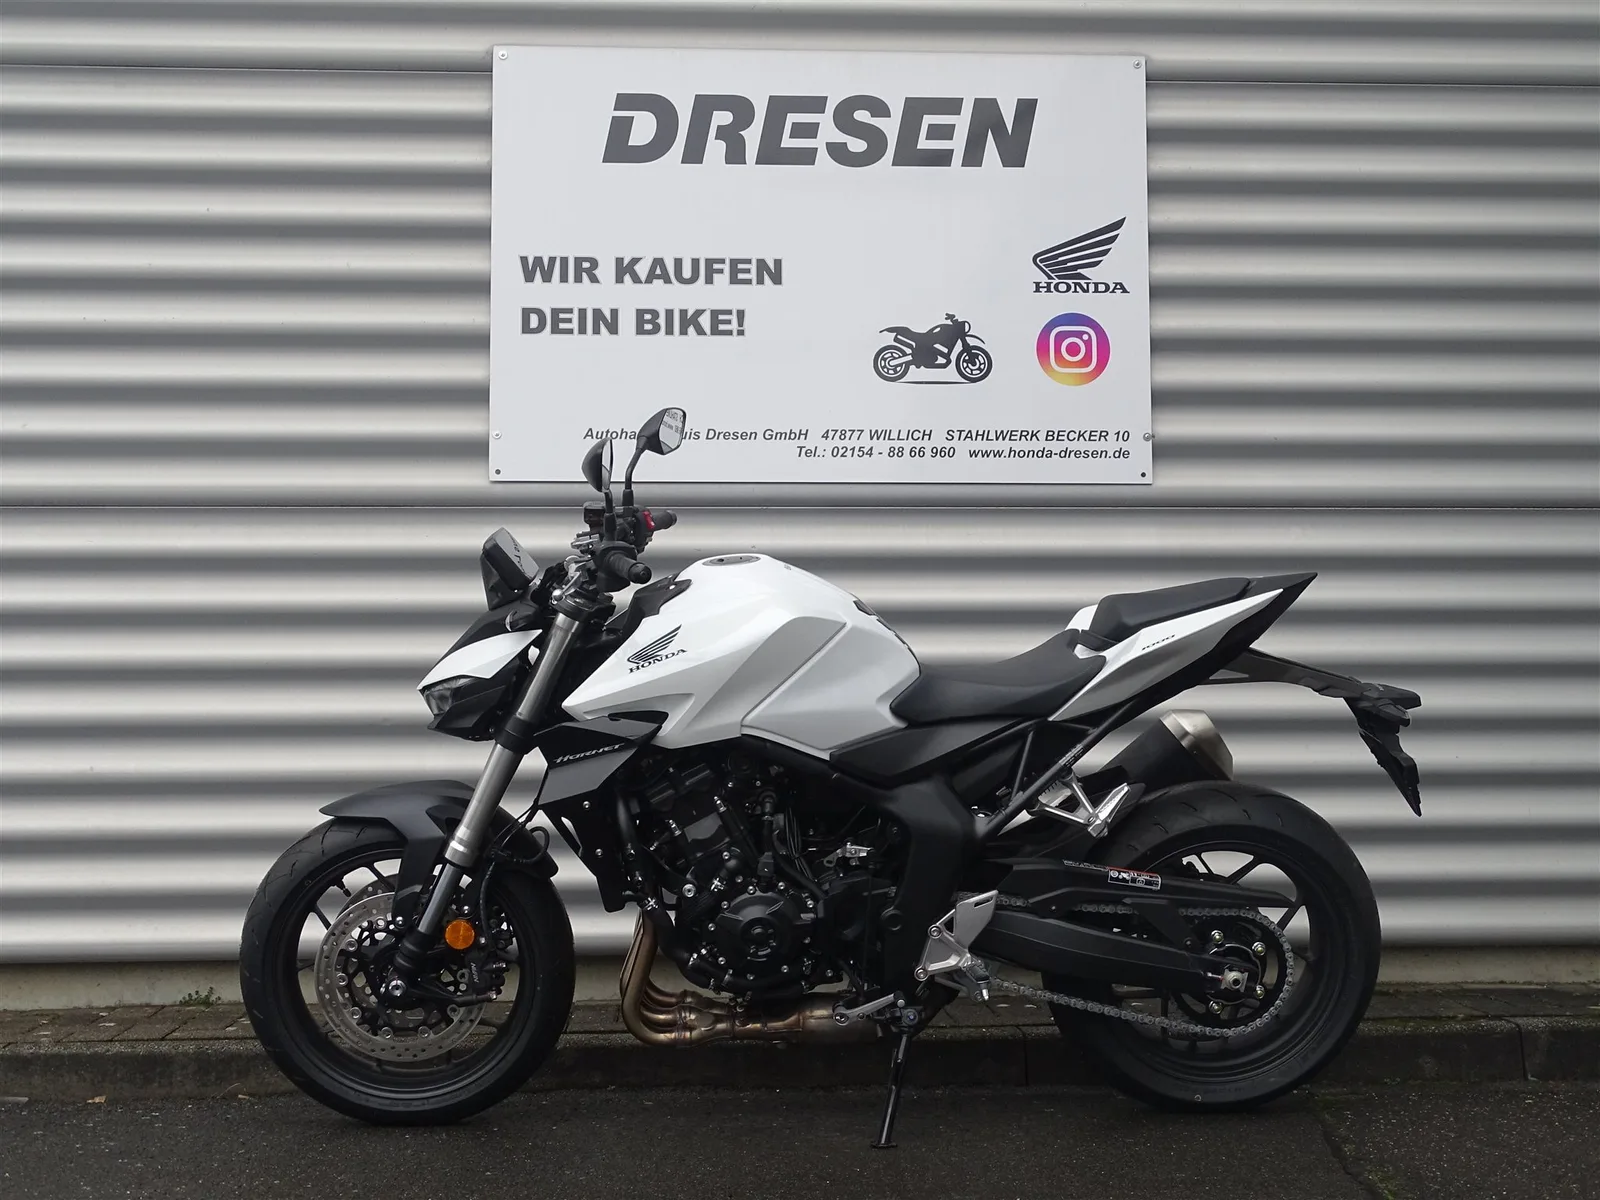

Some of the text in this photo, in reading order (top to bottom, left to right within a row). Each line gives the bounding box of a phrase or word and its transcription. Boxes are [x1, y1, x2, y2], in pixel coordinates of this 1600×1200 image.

[602, 92, 1038, 168] DRESEN
[519, 255, 783, 286] WIR KAUFEN
[1032, 281, 1131, 294] HONDA
[521, 307, 746, 337] DEIN BIKE!
[583, 427, 637, 440] Autoha
[705, 428, 758, 441] Dresen
[762, 428, 809, 441] GmbH
[821, 428, 865, 442] 47877
[869, 428, 933, 442] WILLICH
[945, 429, 1041, 442] STAHLWERK
[1045, 429, 1110, 443] BECKER
[1113, 430, 1131, 443] 10
[796, 445, 827, 458] Tel.:
[831, 445, 874, 459] 02154
[887, 445, 905, 459] 88
[908, 446, 926, 459] 66
[930, 446, 956, 459] 960
[968, 446, 1131, 460] www.honda-dresen.de
[628, 648, 688, 674] HONDA
[553, 742, 625, 764] HORNET
